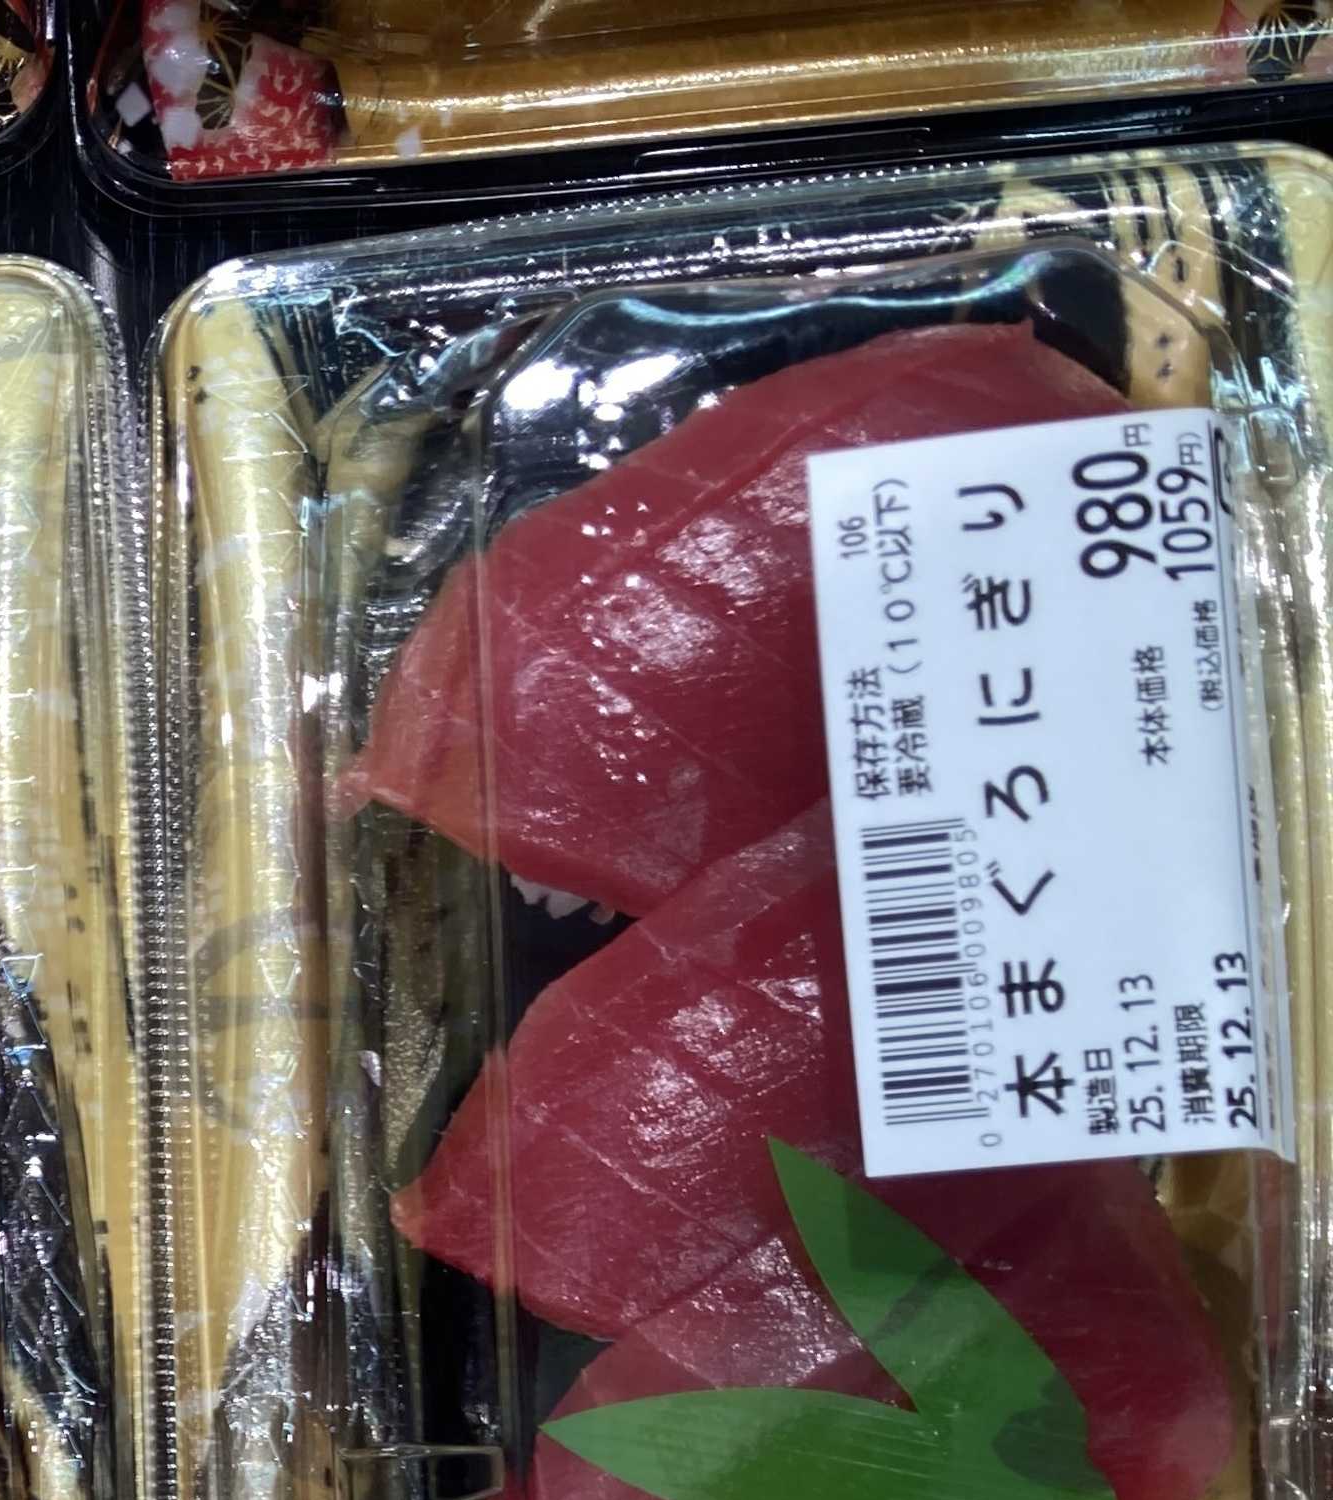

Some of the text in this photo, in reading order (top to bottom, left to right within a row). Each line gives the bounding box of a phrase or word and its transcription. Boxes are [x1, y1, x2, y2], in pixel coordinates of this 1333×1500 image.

[838, 515, 867, 560] 106
[851, 665, 887, 800] 保存方法
[1134, 644, 1170, 766] 本体価格
[959, 482, 1074, 1116] 本まぐろにぎり
[1085, 1046, 1117, 1135] 製造日
[1120, 974, 1166, 1134] 25.12.13
[1175, 1002, 1213, 1125] 消費期限
